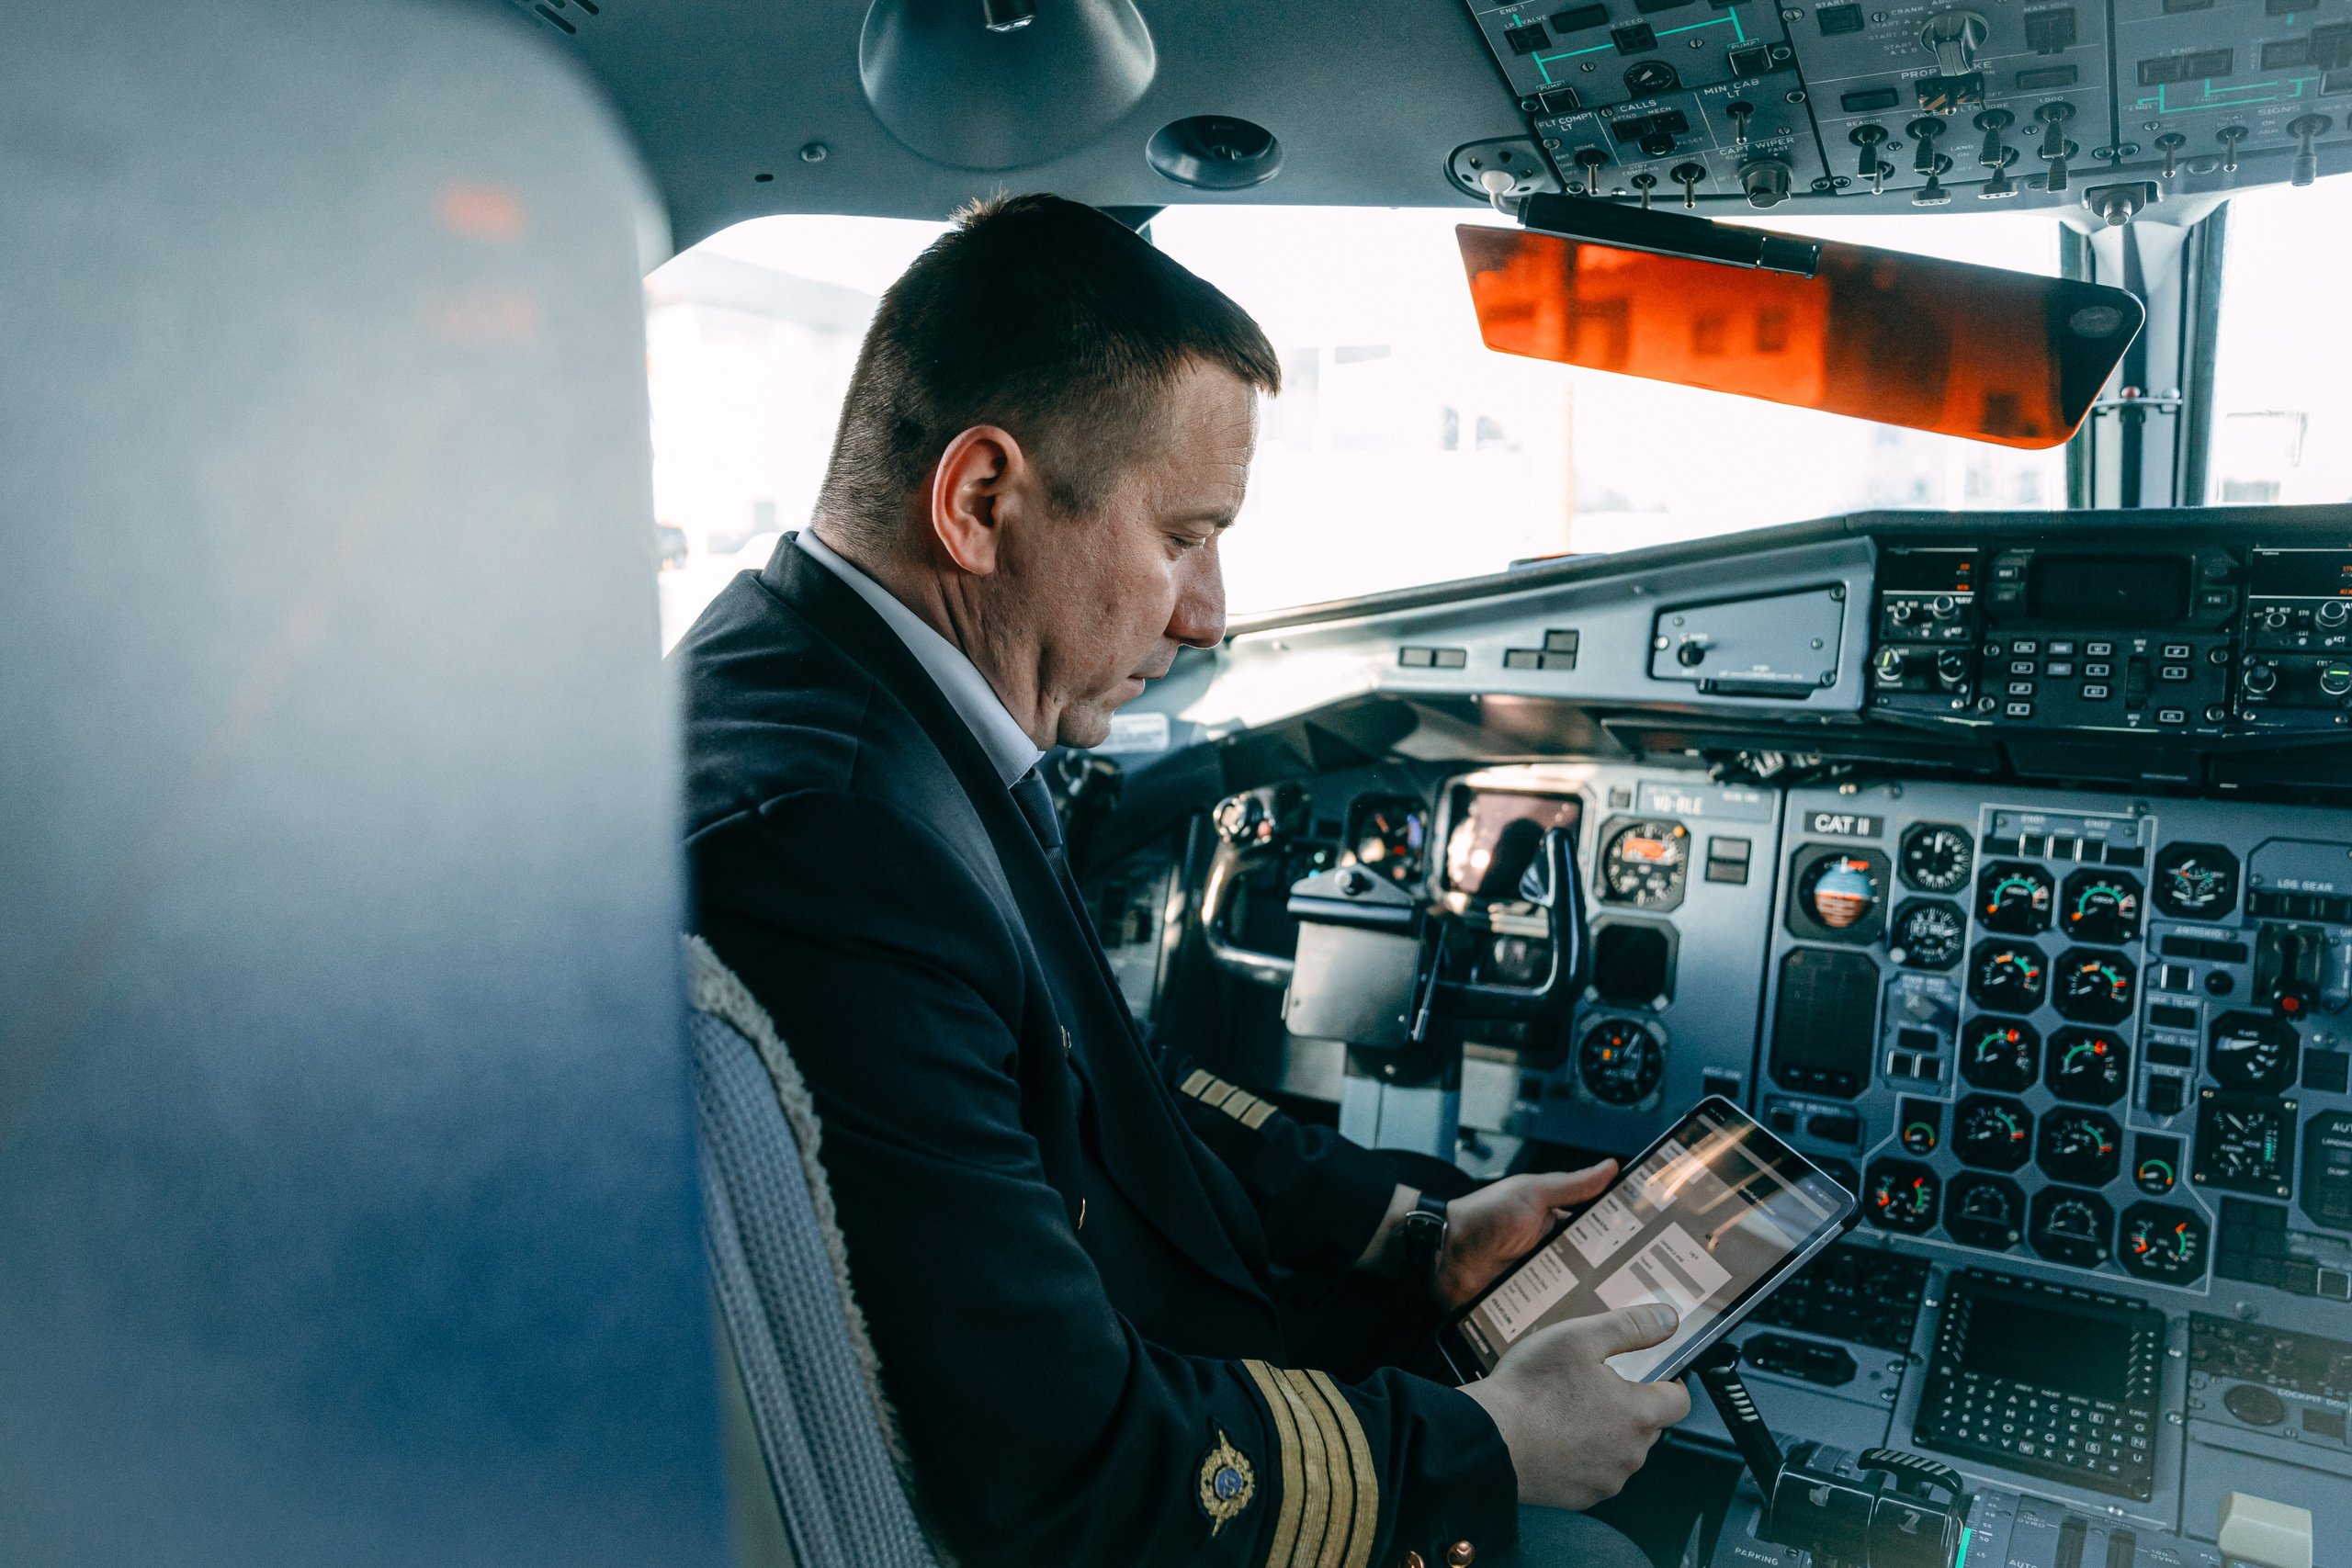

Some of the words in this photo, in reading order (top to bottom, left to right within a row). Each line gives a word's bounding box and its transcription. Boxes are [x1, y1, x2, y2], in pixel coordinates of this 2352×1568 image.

[1499, 7, 1518, 16] ENG
[1891, 6, 1924, 15] CRANK
[1521, 15, 1547, 25] VALVE
[1619, 17, 1644, 28] FEED
[1731, 40, 1757, 50] PUMP
[1901, 69, 1937, 79] PROP
[1539, 83, 1562, 91] PUMP
[1704, 85, 1727, 96] MIN
[1733, 79, 1759, 89] CAB
[1619, 100, 1657, 112] CALLS
[2258, 105, 2301, 116] SIGNS
[1538, 119, 1555, 129] FLT
[1558, 112, 1593, 125] COMPT
[1847, 118, 1882, 127] BEACON
[1676, 137, 1703, 145] RESET
[1720, 145, 1749, 155] CAPT
[1755, 138, 1795, 149] WIPER
[1814, 813, 1854, 834] CAT
[2302, 880, 2334, 892] GEAR
[2008, 1395, 2018, 1404] A
[2277, 1388, 2322, 1404] COCKPIT
[2326, 1398, 2348, 1409] DOO
[2002, 1438, 2011, 1448] V
[2112, 1434, 2122, 1442] M
[2043, 1450, 2052, 1458] X
[2133, 1453, 2143, 1462] U
[2087, 1460, 2096, 1469] Z
[2018, 1517, 2045, 1529] OVRD
[1735, 1547, 1779, 1566] PARKING
[2150, 1554, 2180, 1565] OVRD
